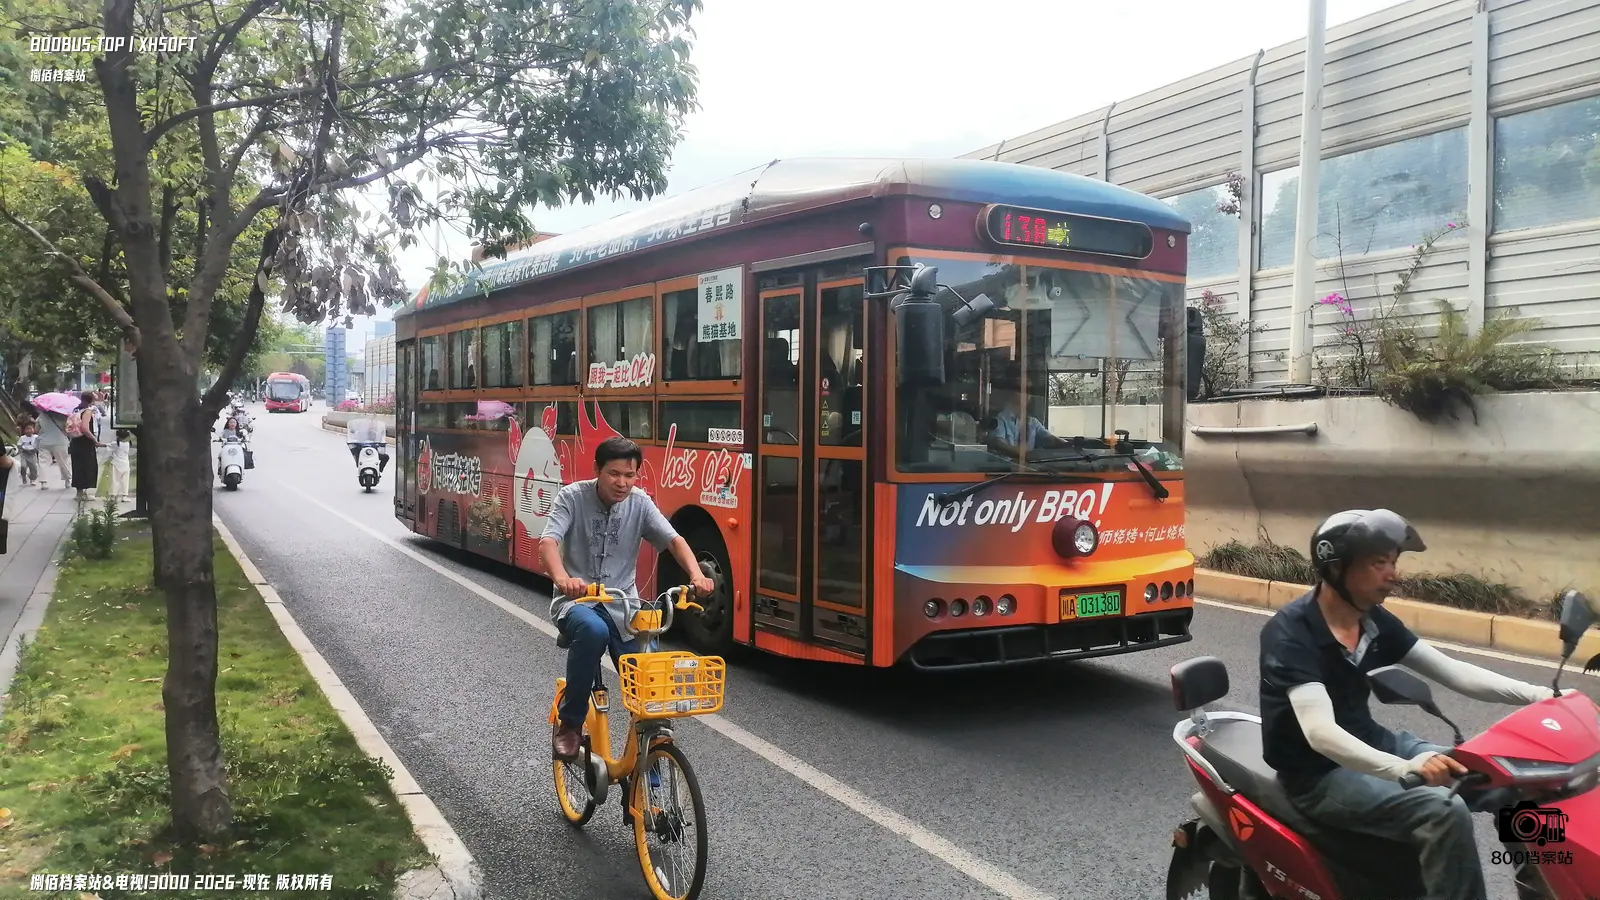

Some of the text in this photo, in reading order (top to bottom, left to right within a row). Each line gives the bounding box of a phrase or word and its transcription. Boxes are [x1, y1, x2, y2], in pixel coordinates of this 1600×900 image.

[705, 283, 734, 303] 春熙路
[702, 321, 737, 340] 熊猫基地
[915, 482, 1114, 532] Not only BBQ!
[1080, 594, 1120, 615] 03138D
